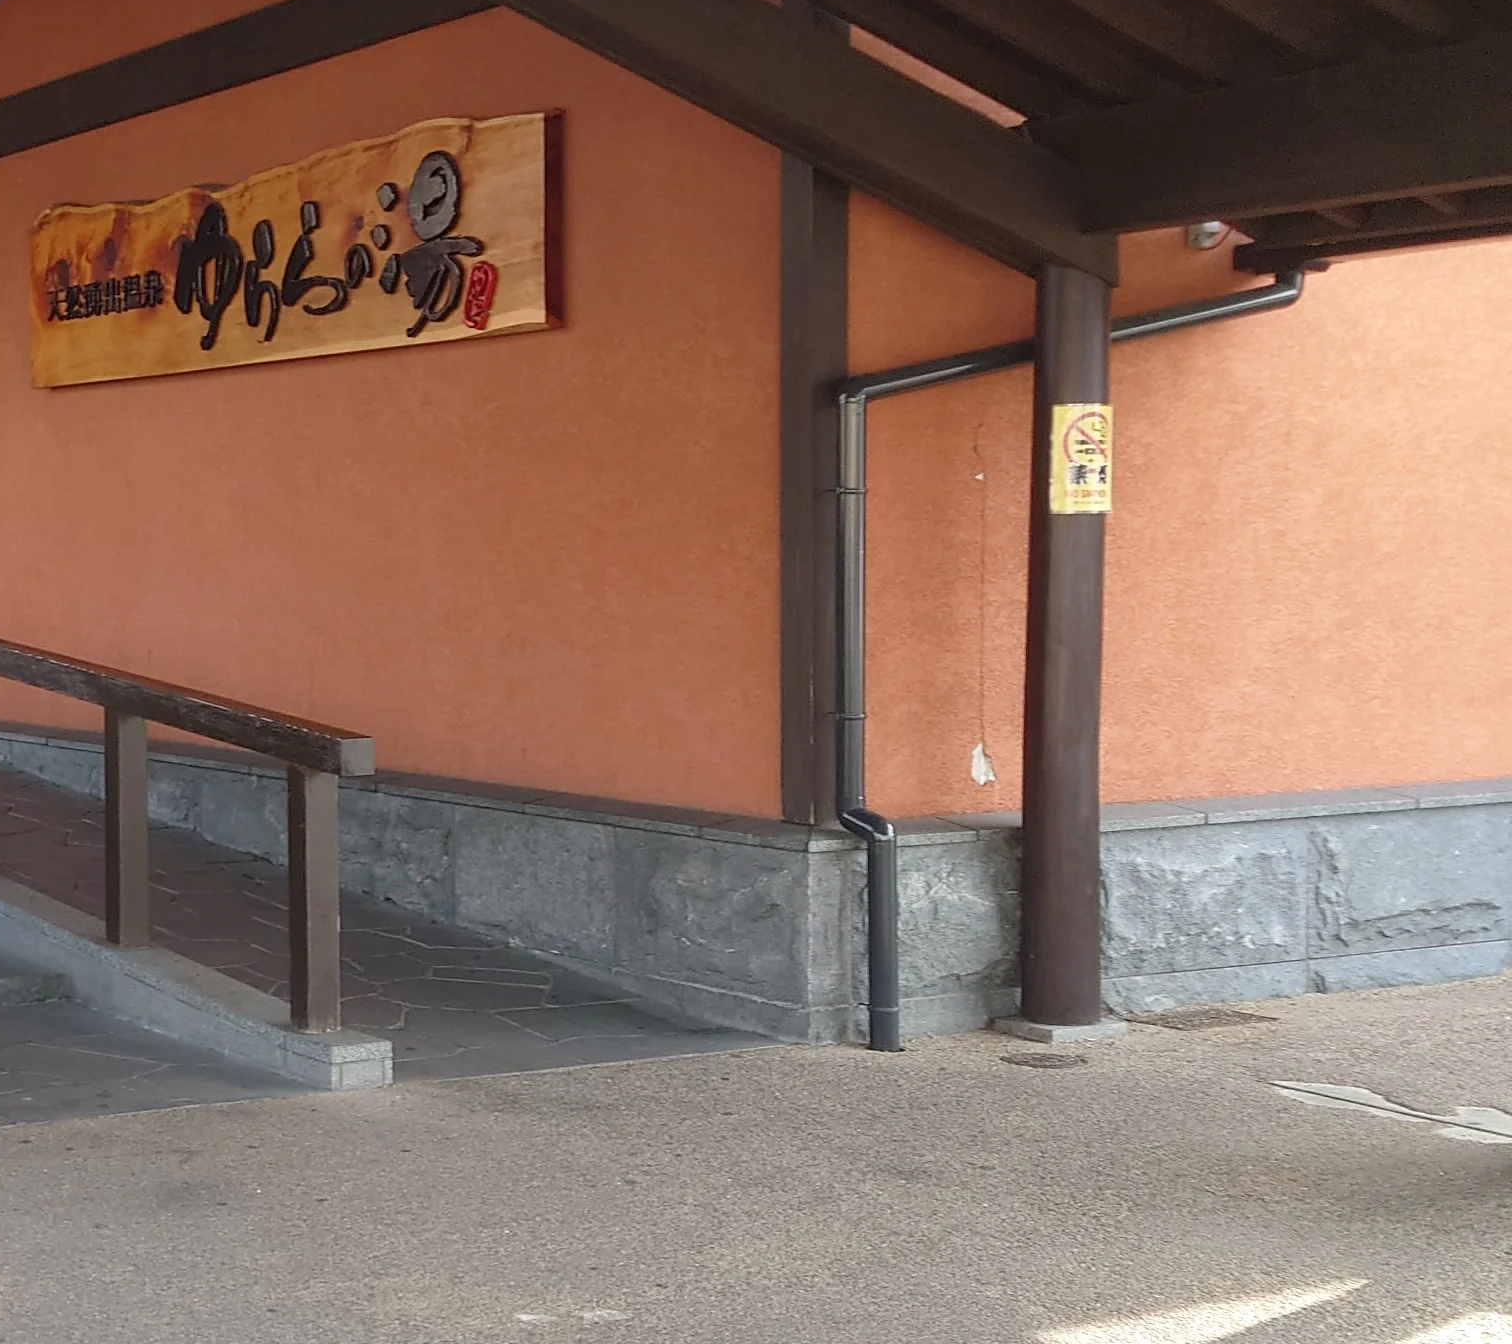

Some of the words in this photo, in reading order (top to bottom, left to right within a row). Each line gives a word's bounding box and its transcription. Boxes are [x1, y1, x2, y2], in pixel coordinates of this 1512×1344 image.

[174, 150, 483, 350] ゆららの湯
